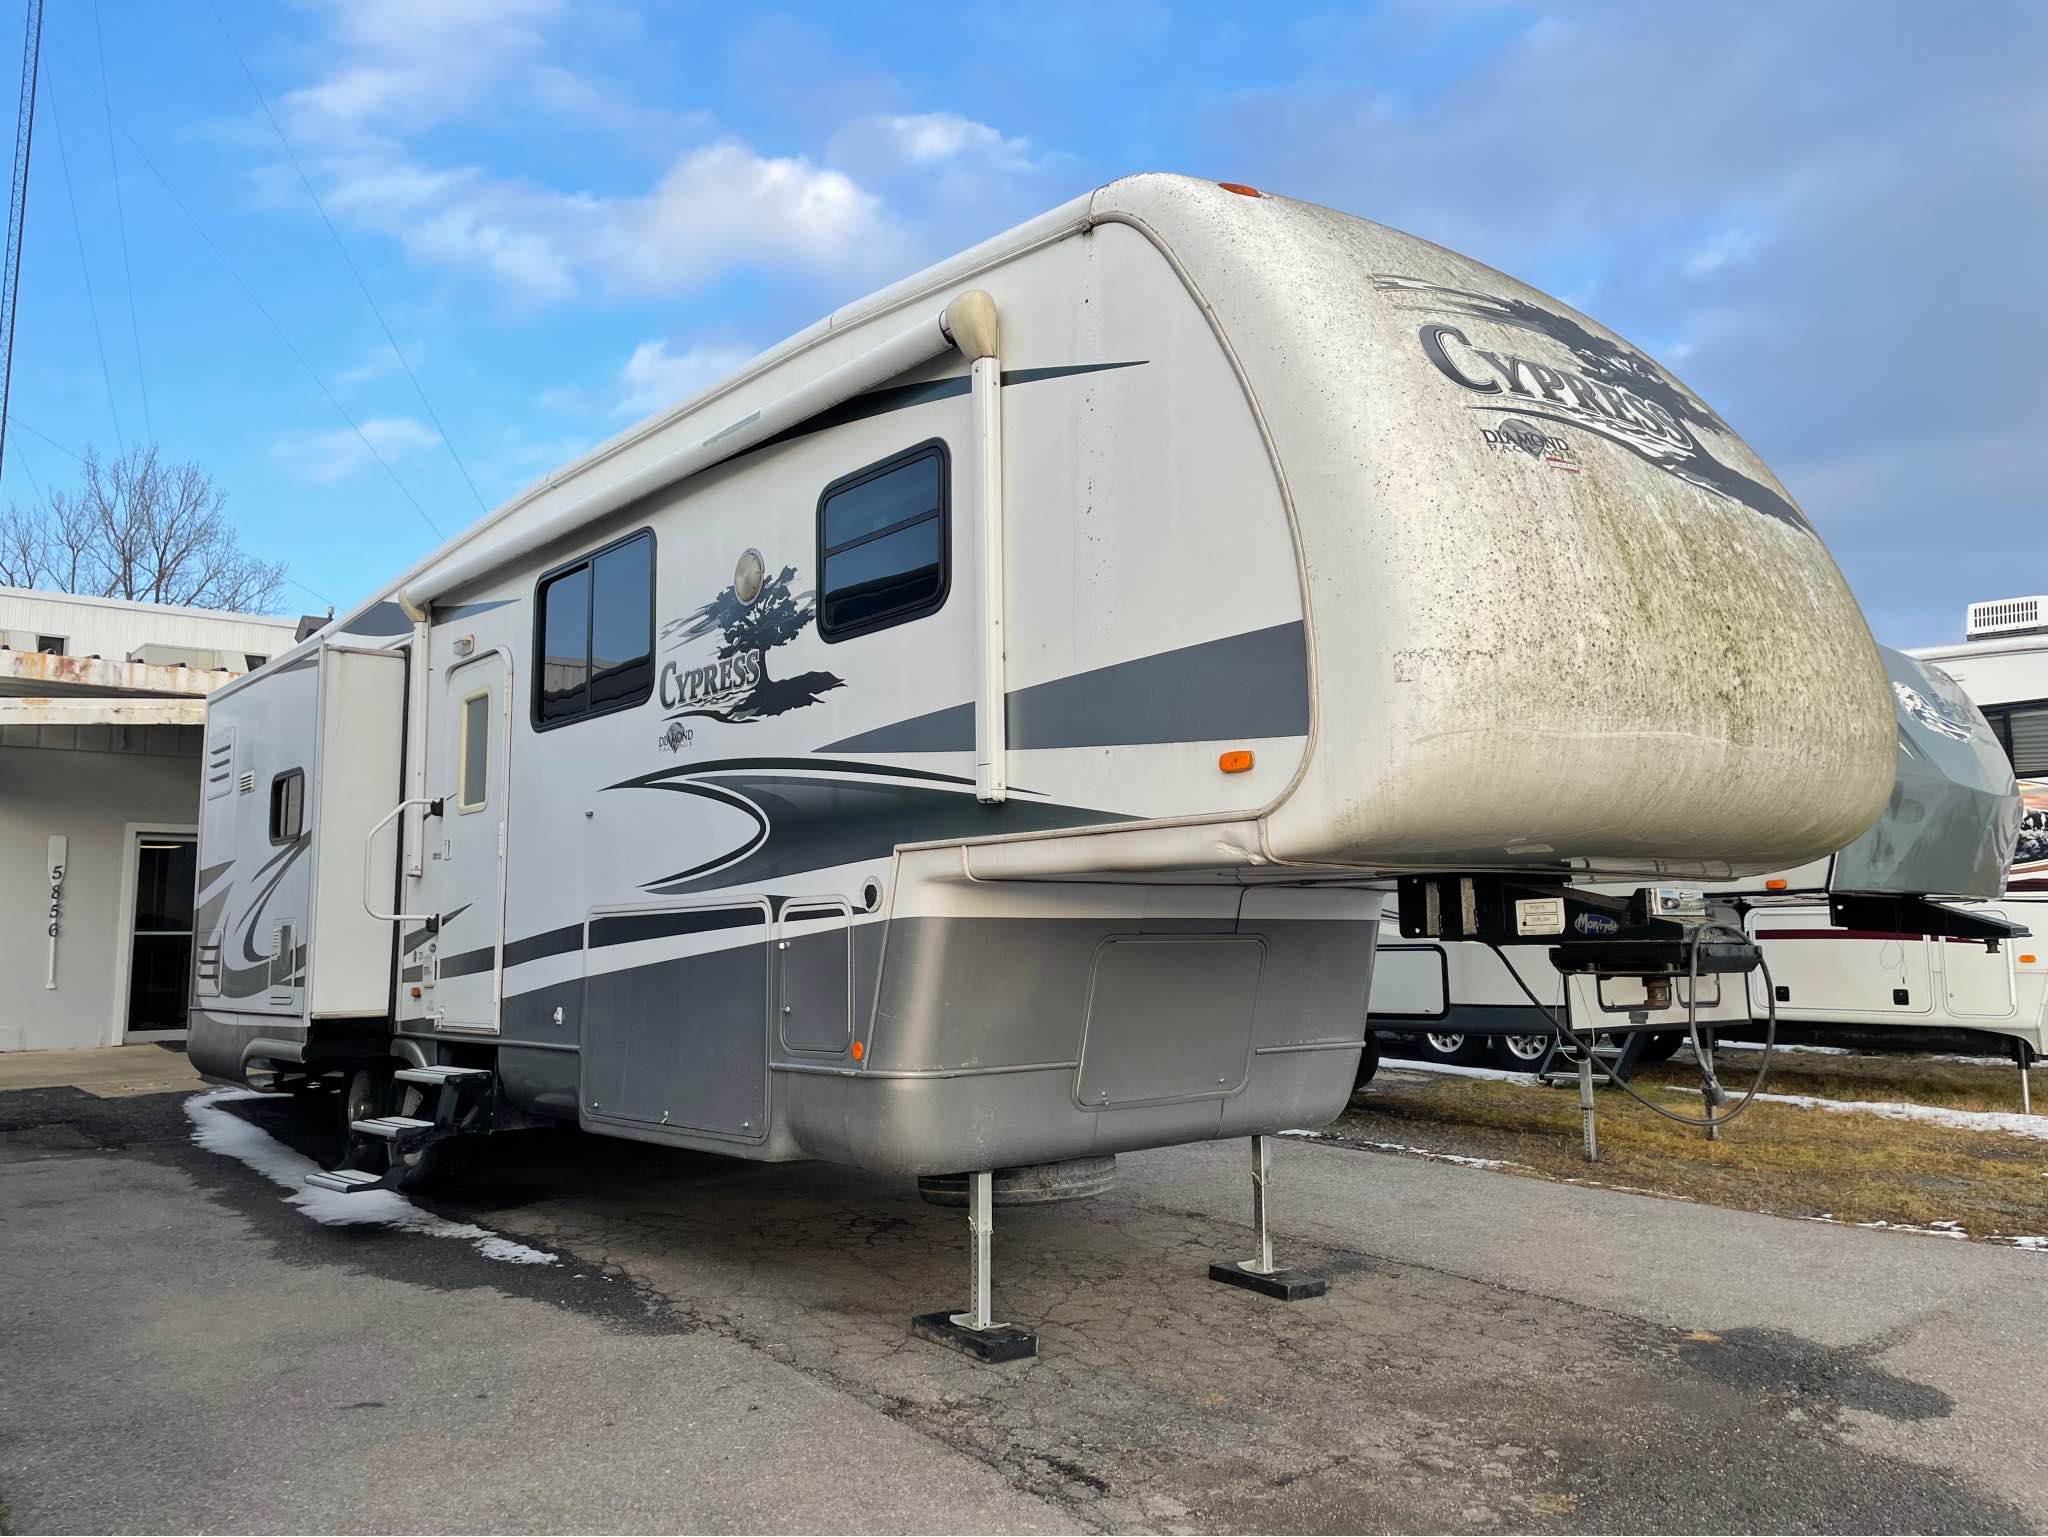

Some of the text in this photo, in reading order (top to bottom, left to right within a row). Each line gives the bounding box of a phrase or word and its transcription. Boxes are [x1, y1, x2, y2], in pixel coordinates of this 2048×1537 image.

[1419, 323, 1693, 450] CYPRESS
[1480, 429, 1569, 451] DIAMOND
[1488, 443, 1577, 459] PACAGE
[660, 649, 760, 710] CYPRESS
[48, 865, 63, 937] 5856
